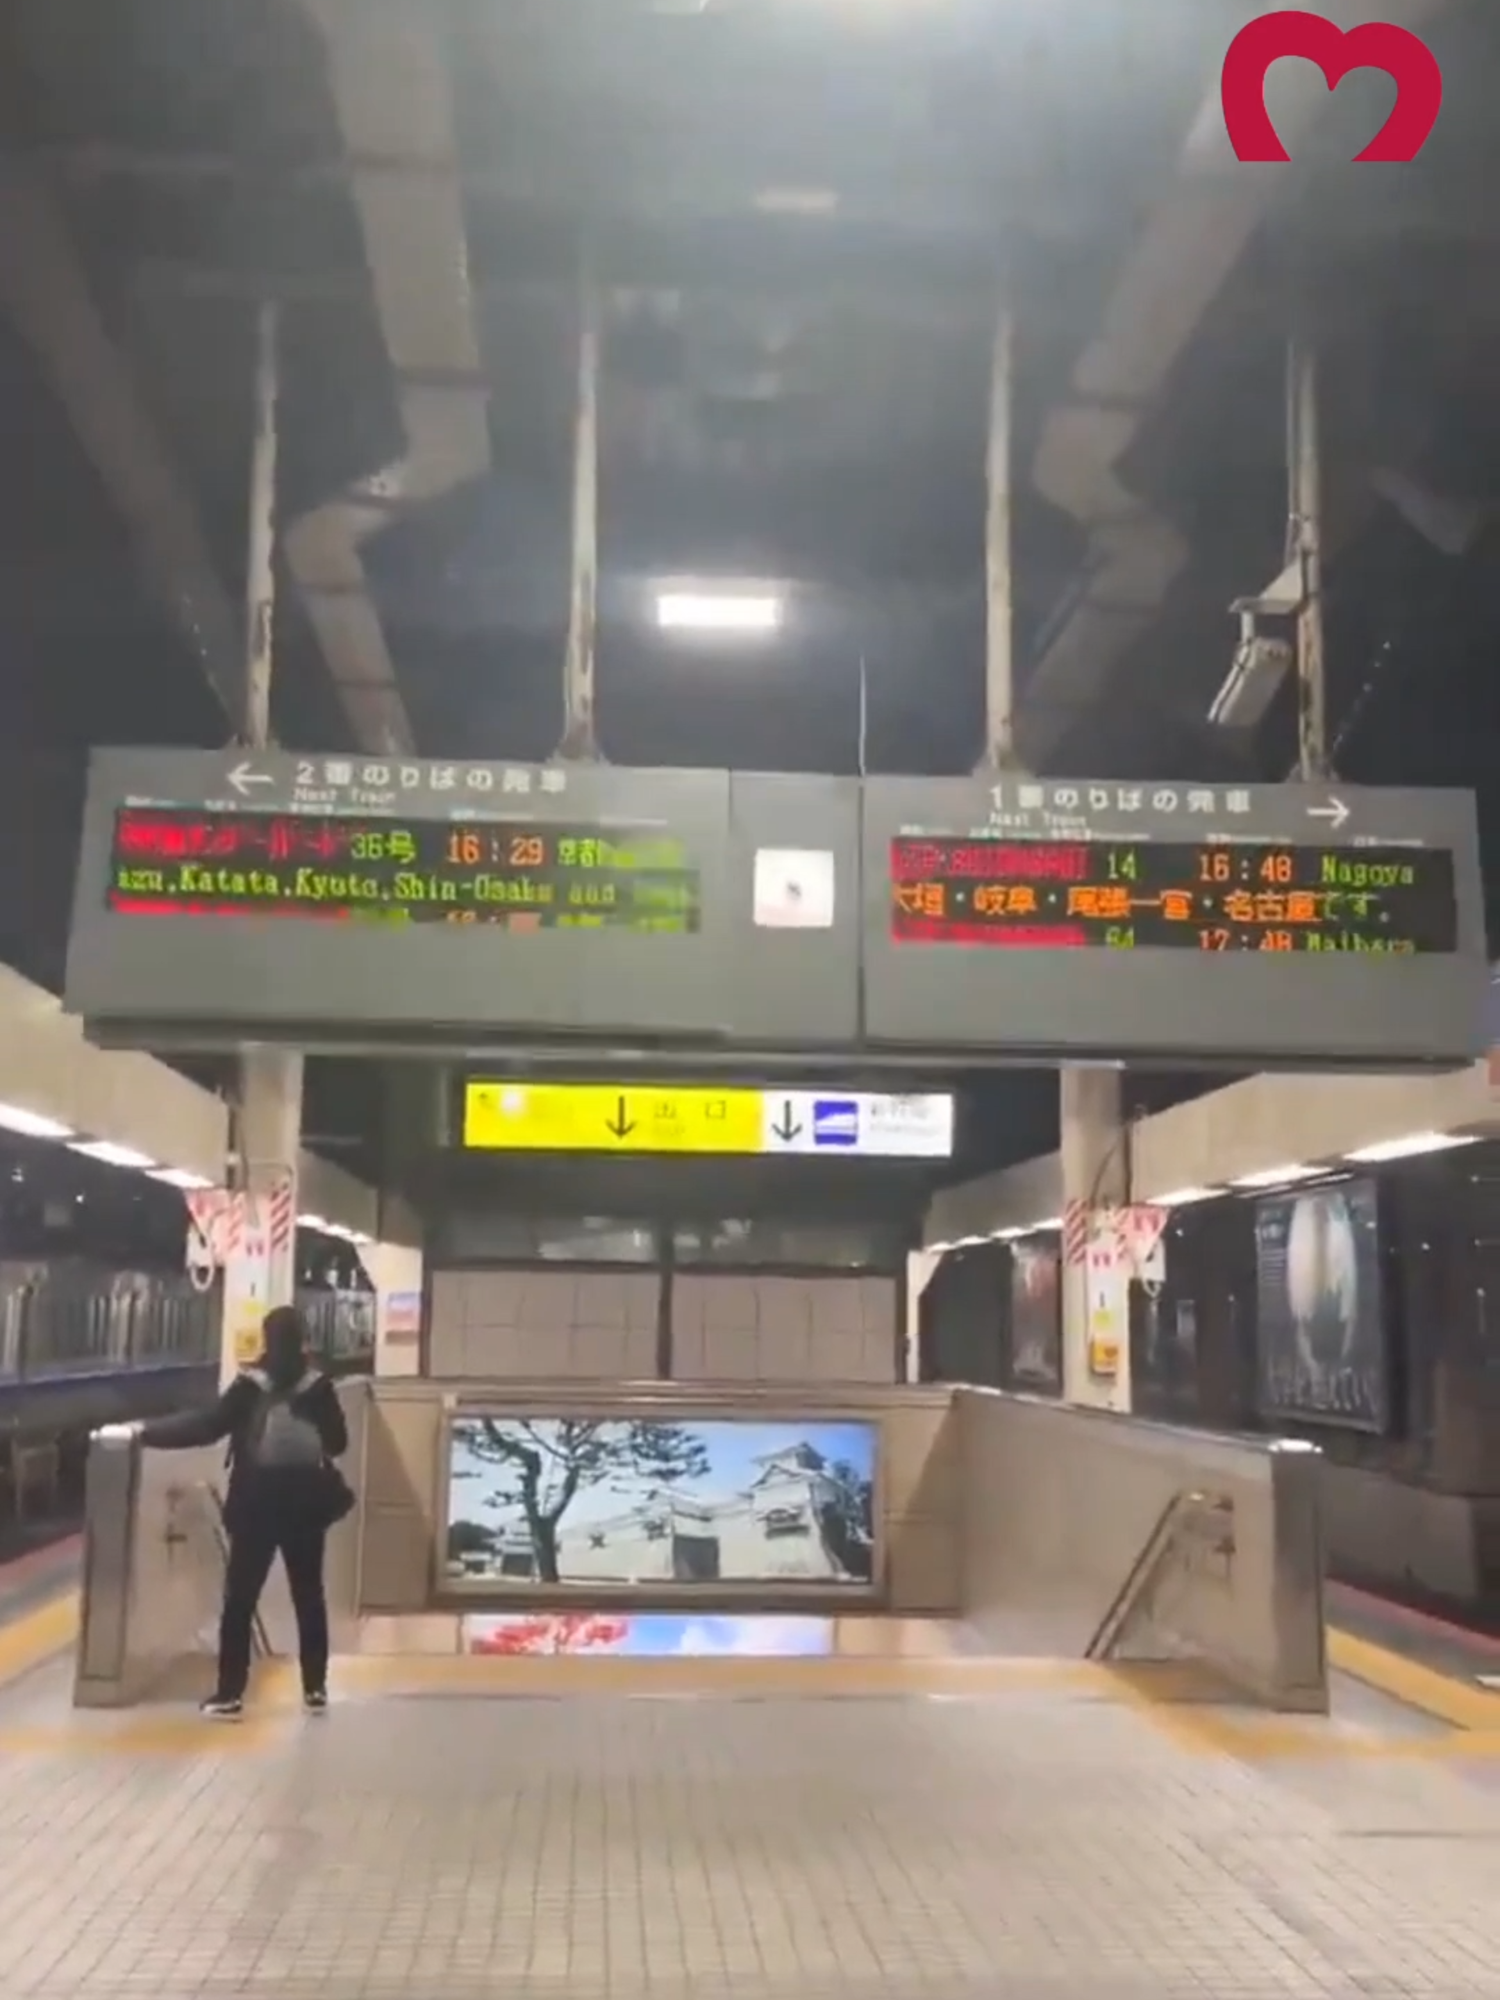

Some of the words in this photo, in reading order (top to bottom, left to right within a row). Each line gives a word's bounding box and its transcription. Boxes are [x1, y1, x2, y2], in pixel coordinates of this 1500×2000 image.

[989, 784, 1251, 814] 1のりばの発車
[446, 829, 544, 866] 16:29
[1107, 851, 1138, 880] 14
[1320, 854, 1415, 887] Nagoya
